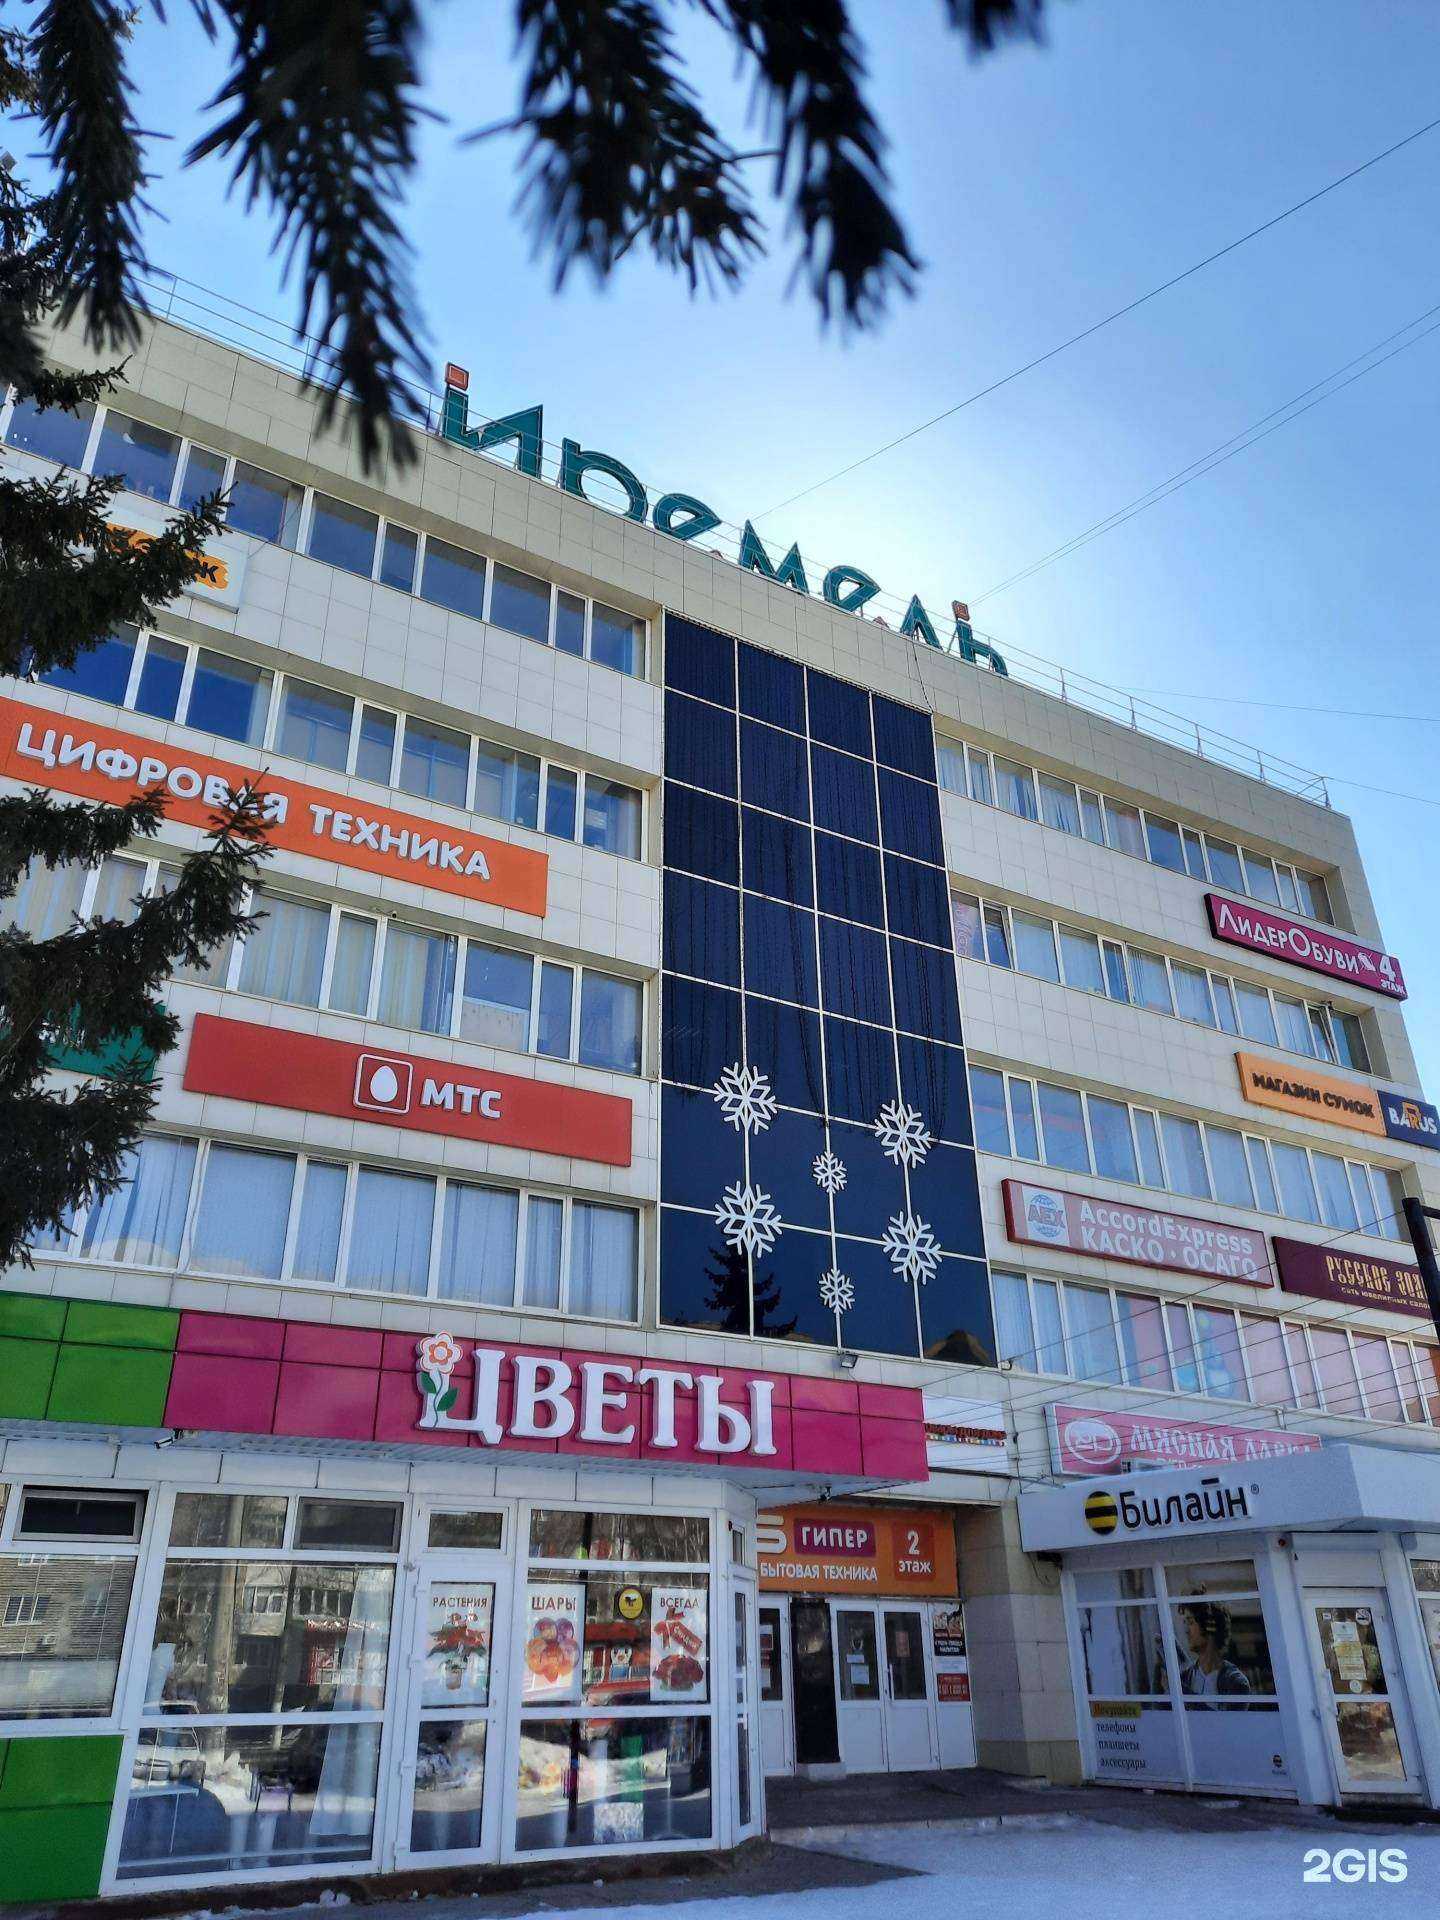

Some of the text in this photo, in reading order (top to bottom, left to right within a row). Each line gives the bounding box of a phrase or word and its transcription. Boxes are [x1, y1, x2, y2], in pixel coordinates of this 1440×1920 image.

[308, 803, 491, 882] ТЕХНИКА
[1379, 954, 1397, 982] 4
[420, 1078, 503, 1119] МТС
[1252, 1072, 1376, 1119] МАГАЗИН СУМОК
[1080, 1225, 1258, 1281] КАСКО ОСАГО
[415, 1331, 779, 1456] ЦВЕТЫ
[1118, 1476, 1249, 1531] билайн
[801, 1525, 869, 1550] ГИПЕР
[906, 1530, 921, 1556] 2
[760, 1561, 879, 1585] БЫТОВАЯ ТЕХНИКА
[898, 1559, 933, 1575] этаж
[432, 1596, 489, 1609] РАСТЕНИЯ
[530, 1596, 577, 1611] ШАРЫ
[659, 1597, 701, 1609] ВСЕГДА
